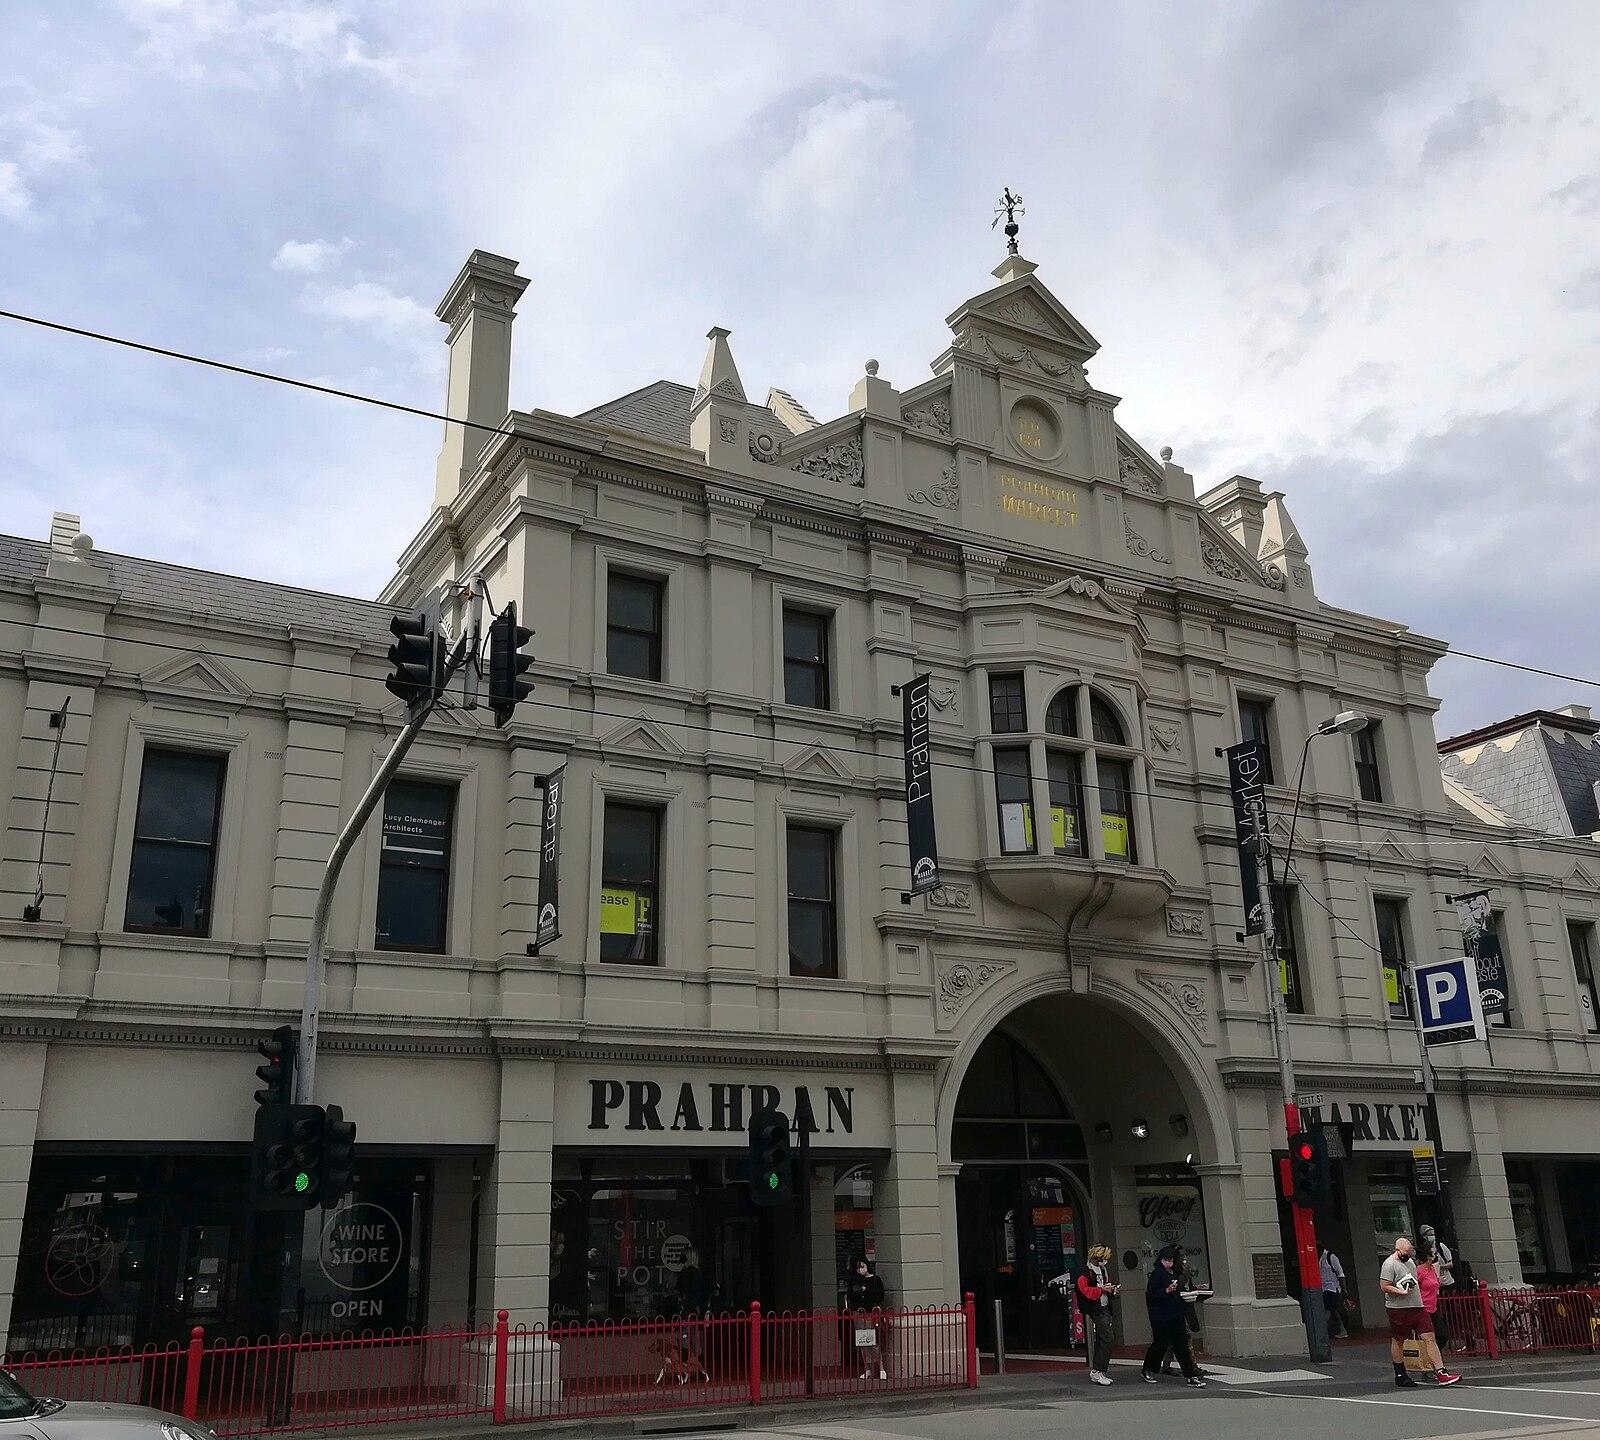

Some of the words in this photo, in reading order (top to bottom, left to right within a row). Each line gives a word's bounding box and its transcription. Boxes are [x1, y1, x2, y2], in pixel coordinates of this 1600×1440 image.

[908, 682, 931, 804] Prahran
[546, 781, 560, 830] rear
[383, 813, 402, 823] Lucy
[1101, 820, 1124, 831] ease
[383, 823, 424, 834] Architects
[543, 834, 556, 863] at
[600, 894, 630, 906] ease
[1477, 954, 1502, 971] bout
[1477, 968, 1499, 982] aste
[1425, 971, 1458, 1020] P
[588, 1080, 854, 1134] PRAHRAN
[338, 1224, 386, 1240] WINE
[613, 1218, 668, 1241] STIR
[331, 1246, 390, 1265] STORE
[624, 1244, 656, 1260] THE
[617, 1265, 667, 1287] POT
[330, 1299, 383, 1318] OPEN
